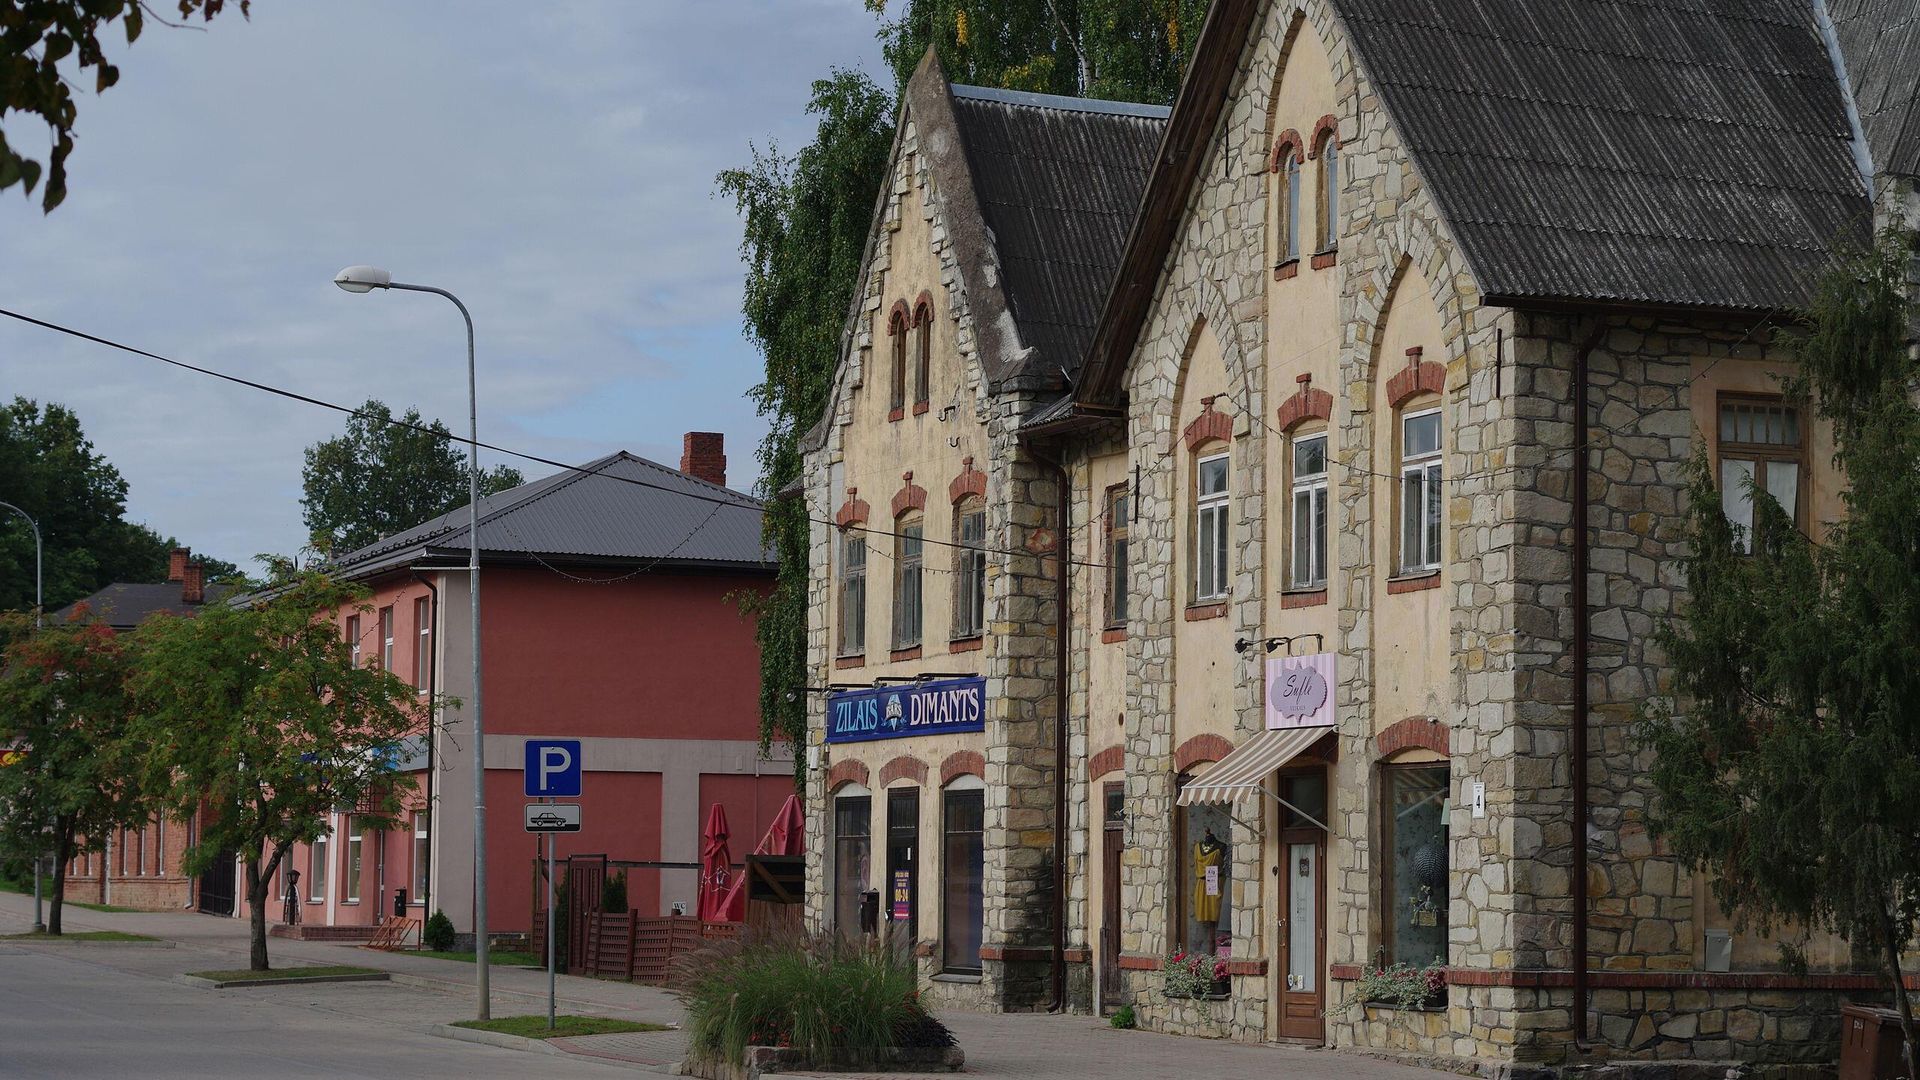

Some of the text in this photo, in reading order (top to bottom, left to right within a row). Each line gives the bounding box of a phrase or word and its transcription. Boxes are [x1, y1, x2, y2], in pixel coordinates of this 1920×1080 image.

[835, 687, 979, 732] ZILAIS DIMANTS
[540, 747, 571, 790] P
[674, 902, 686, 910] WC
